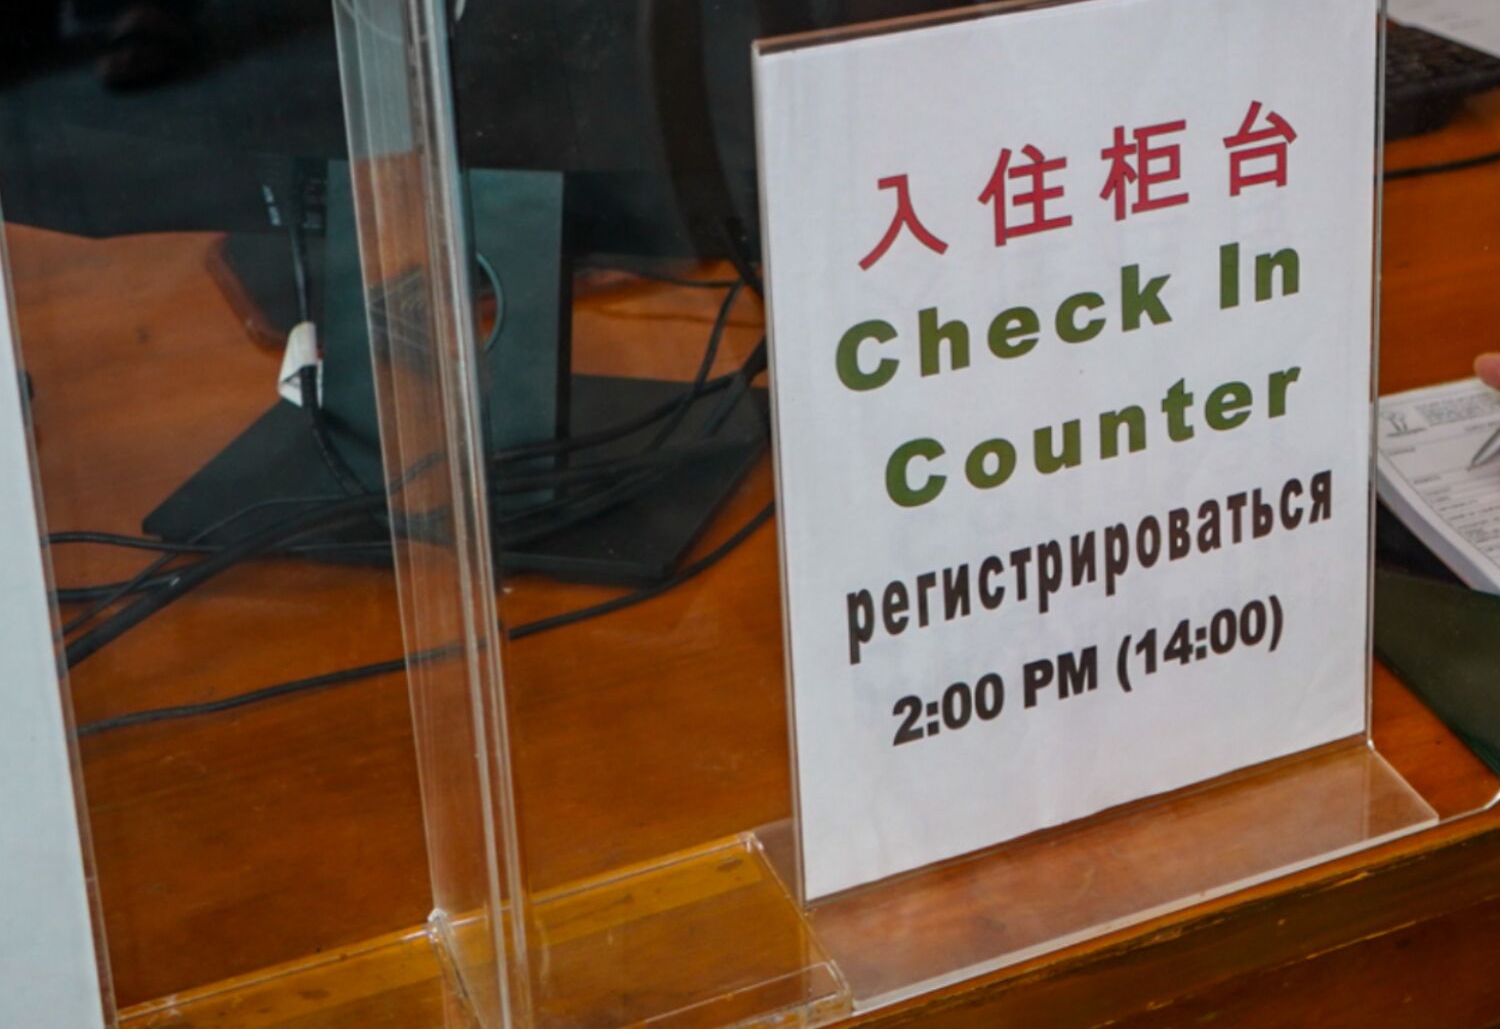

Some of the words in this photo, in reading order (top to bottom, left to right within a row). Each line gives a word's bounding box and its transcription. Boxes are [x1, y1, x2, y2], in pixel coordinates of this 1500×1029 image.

[858, 100, 1297, 271] 入住柜台
[835, 263, 1172, 392] Check
[1219, 242, 1300, 310] In
[885, 366, 1301, 508] Counter
[846, 469, 1332, 666] регистрироваться
[892, 672, 1005, 747] 2:00
[1022, 644, 1098, 710] PM
[1116, 594, 1284, 693] (14:00)
